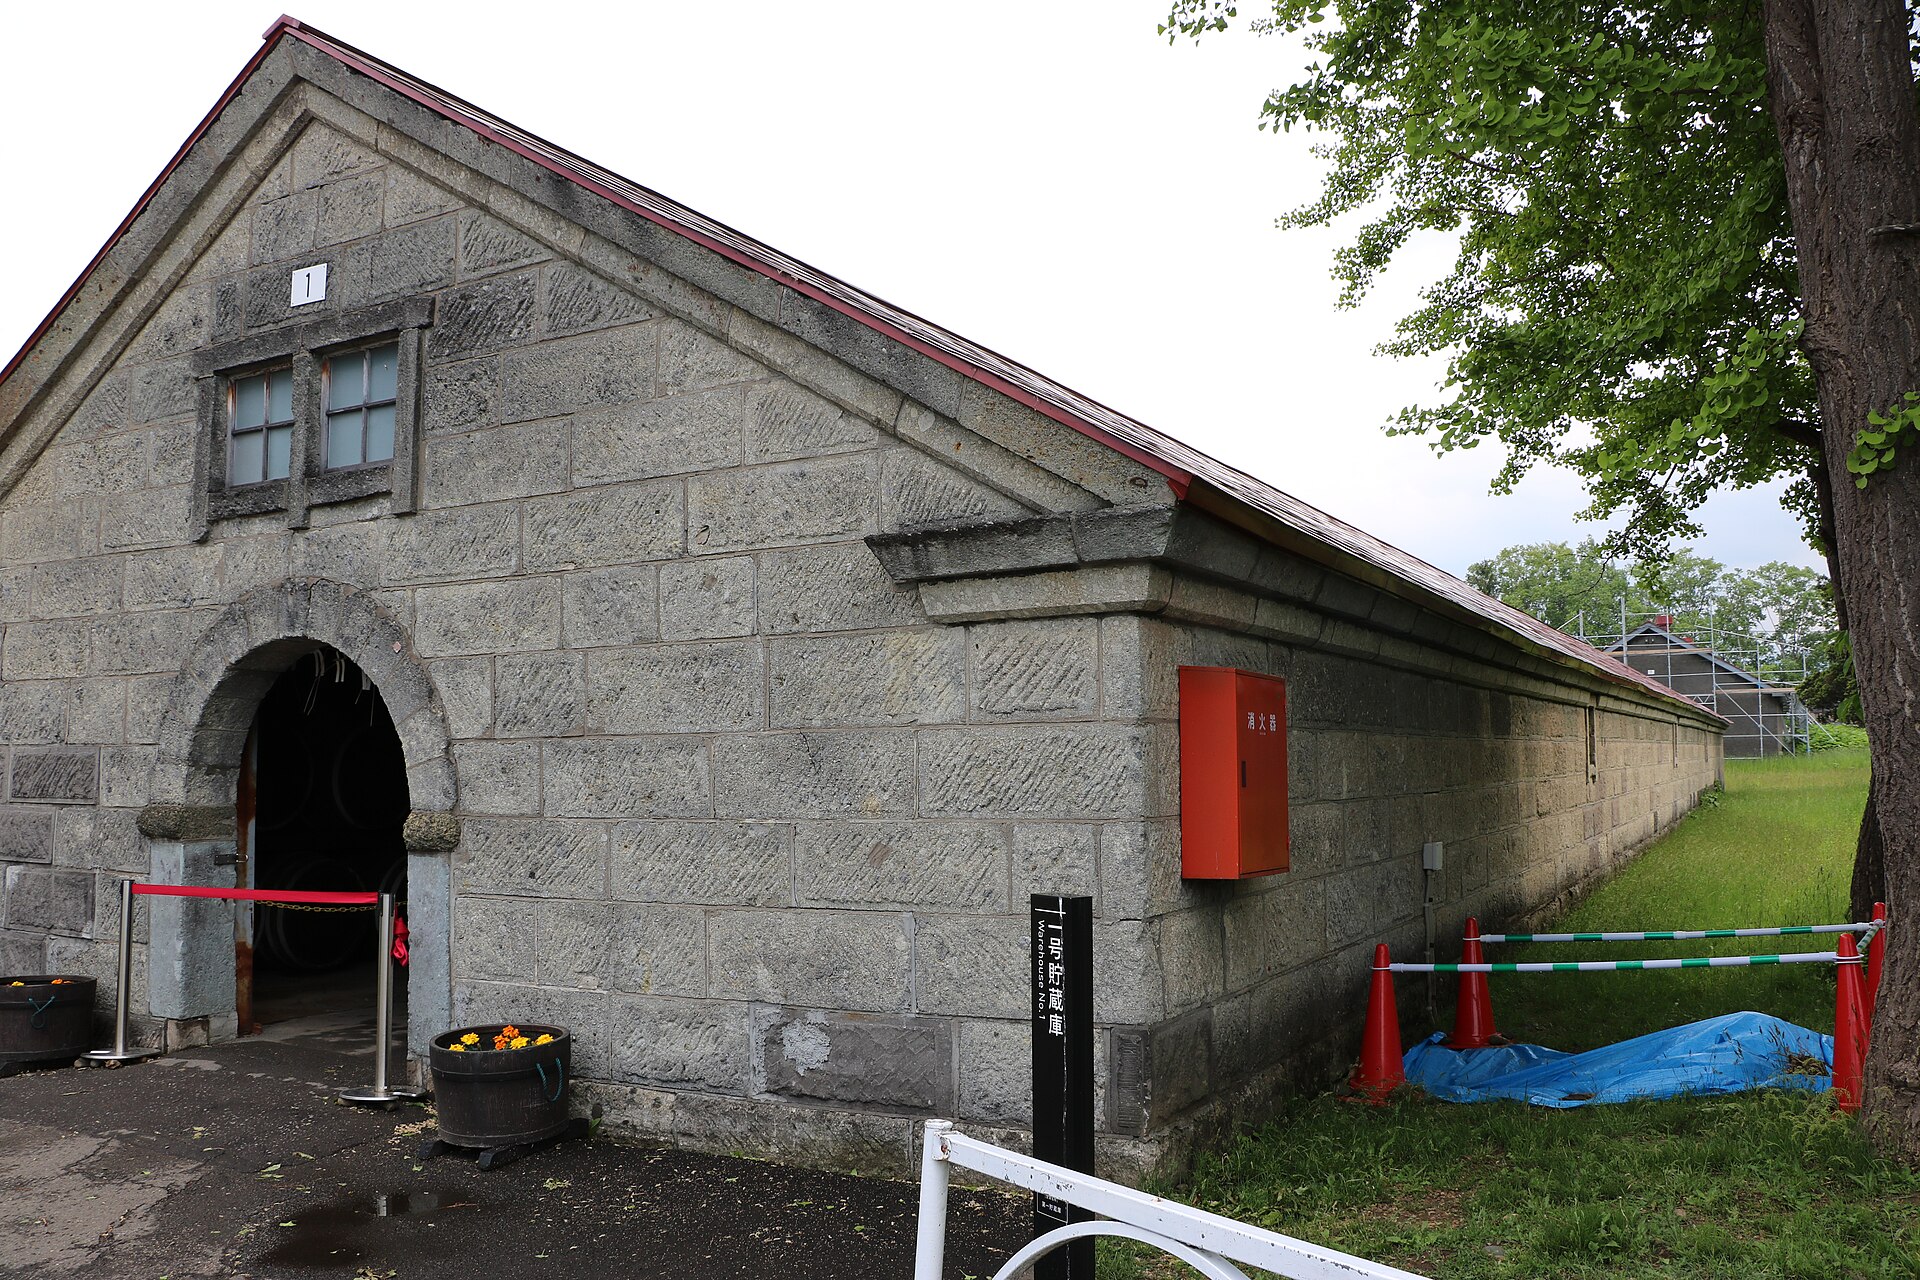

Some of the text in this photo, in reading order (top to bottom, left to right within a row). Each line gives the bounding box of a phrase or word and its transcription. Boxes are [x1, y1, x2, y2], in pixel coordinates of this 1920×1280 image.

[305, 272, 311, 298] 1
[1247, 711, 1277, 732] 消火器
[1037, 919, 1046, 1020] Warehouse No.1
[1047, 924, 1064, 1037] 一号貯蔵庫
